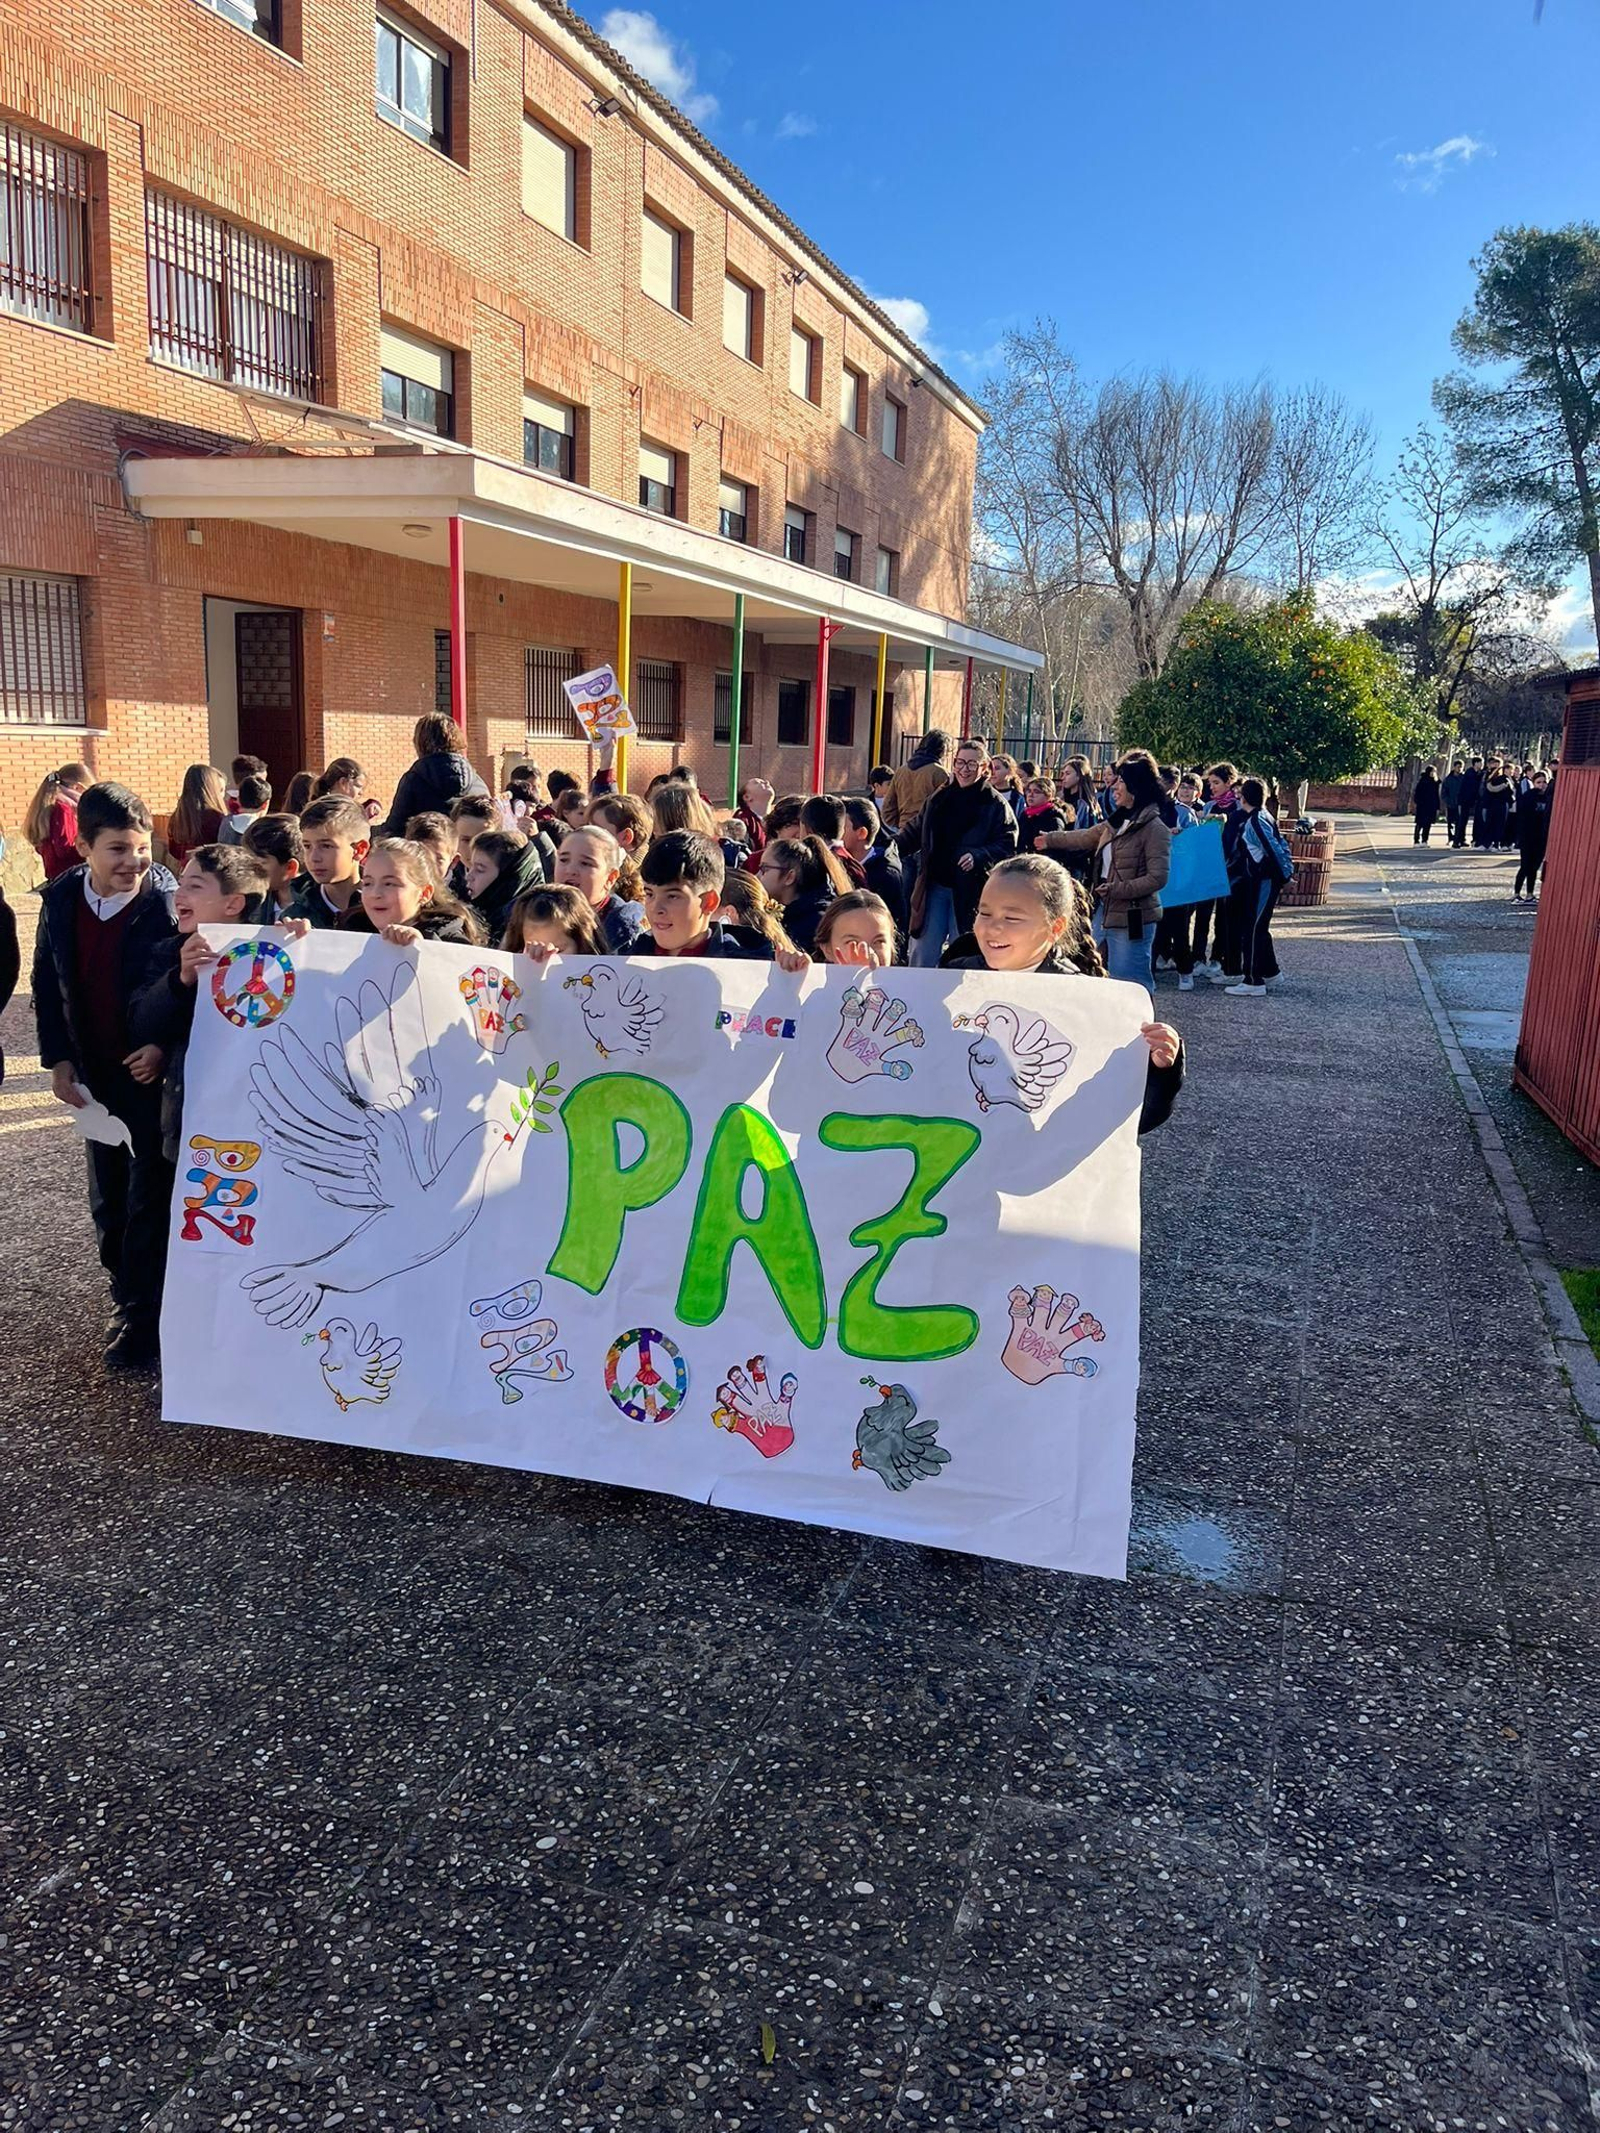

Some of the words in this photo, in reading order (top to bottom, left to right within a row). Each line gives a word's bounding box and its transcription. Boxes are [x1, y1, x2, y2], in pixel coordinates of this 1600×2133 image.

[478, 1008, 505, 1033] PAZ
[714, 1010, 797, 1039] PEACE
[843, 1027, 881, 1067] PAZ
[181, 1134, 262, 1246] PAZ
[545, 1072, 981, 1362] PAZ
[469, 1279, 575, 1405] PAZ
[1017, 1327, 1060, 1367] PAZ
[747, 1401, 783, 1437] PAZ
